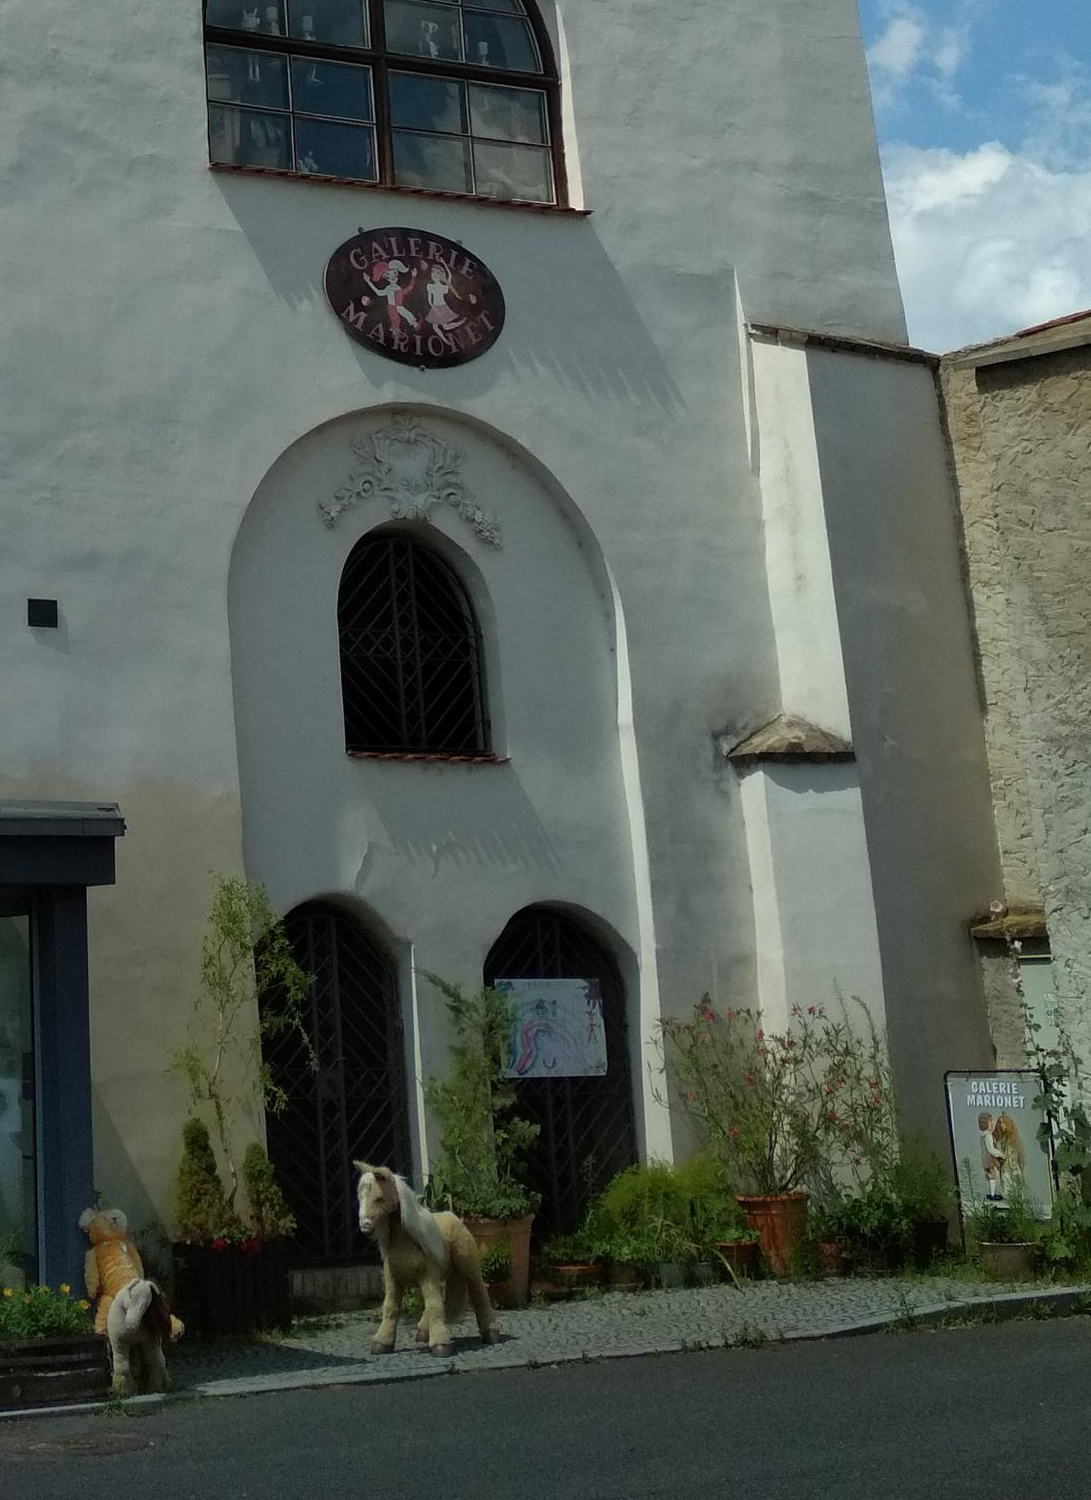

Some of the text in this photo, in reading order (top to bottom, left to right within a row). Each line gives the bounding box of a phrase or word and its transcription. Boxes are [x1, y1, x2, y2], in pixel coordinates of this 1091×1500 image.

[349, 236, 478, 280] GALERIE
[340, 300, 496, 357] MARIONET
[966, 1093, 1025, 1109] MARIONET
[970, 1080, 1019, 1096] GALERIE
